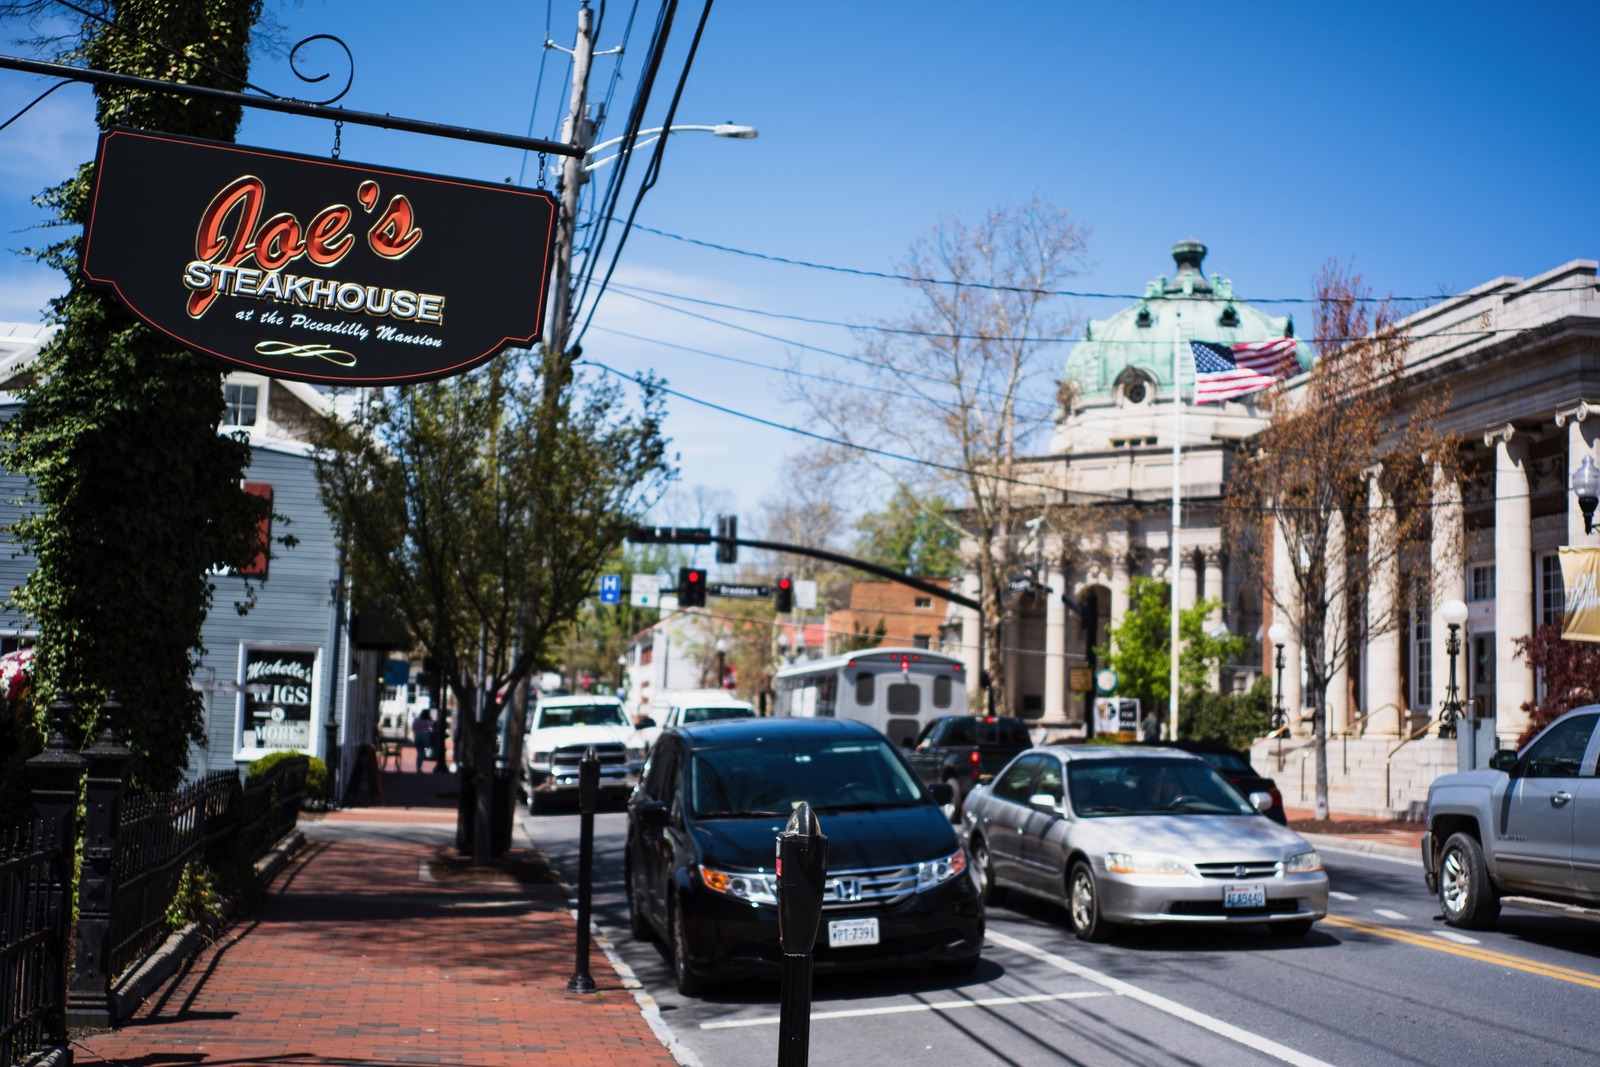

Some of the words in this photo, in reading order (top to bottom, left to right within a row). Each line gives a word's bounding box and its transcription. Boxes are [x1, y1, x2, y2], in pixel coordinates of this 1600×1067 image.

[187, 175, 423, 318] Joe's
[183, 261, 445, 325] STEAKHOUSE
[235, 309, 254, 321] at
[260, 310, 284, 326] the
[290, 313, 370, 340] Piccadilly
[375, 324, 443, 348] Mansion
[604, 577, 616, 591] H
[720, 586, 758, 596] Braddock
[246, 659, 311, 683] Michelle's
[252, 685, 308, 706] WIGS
[255, 725, 299, 741] MORE
